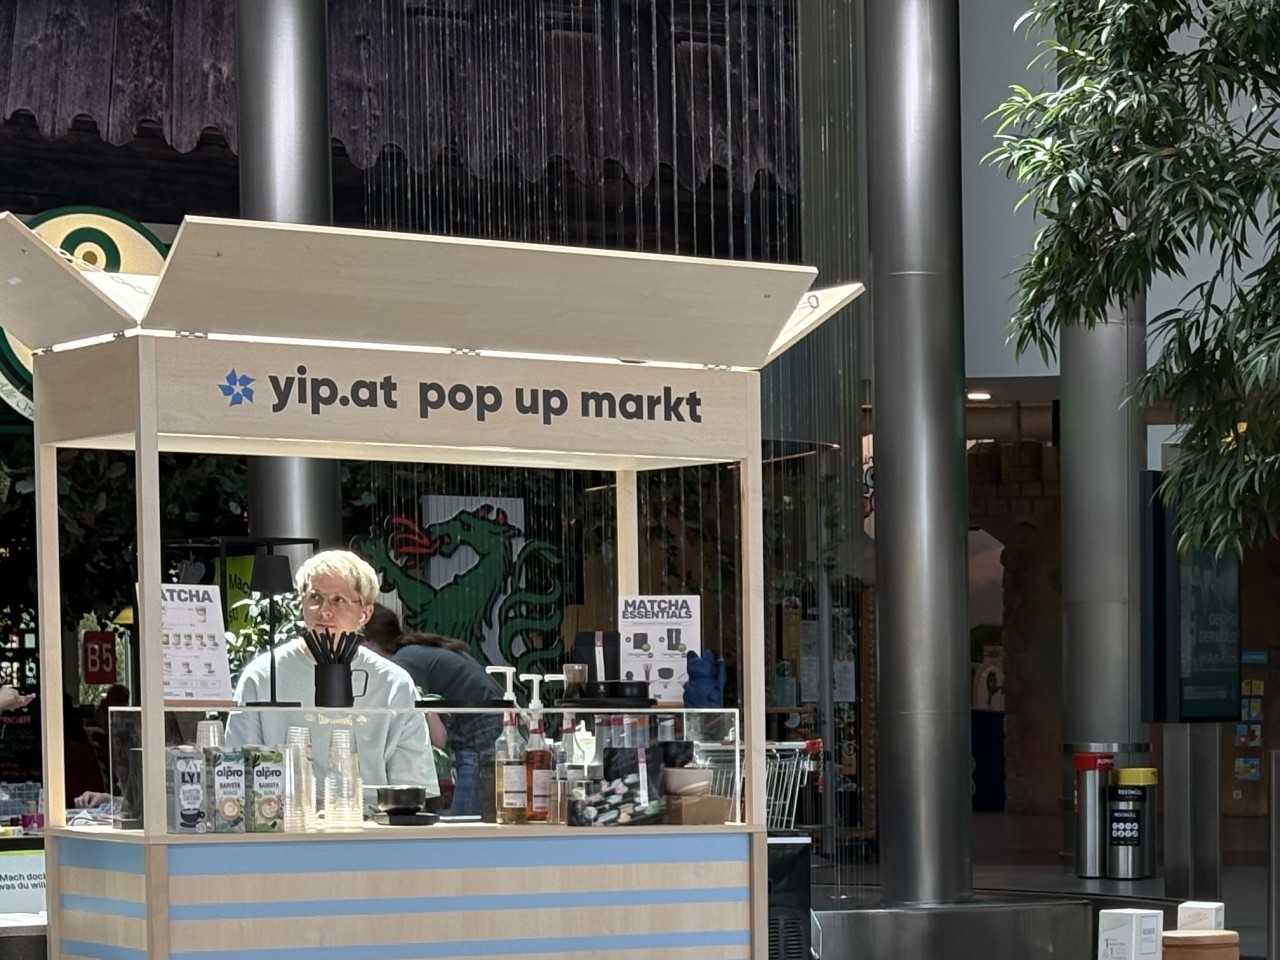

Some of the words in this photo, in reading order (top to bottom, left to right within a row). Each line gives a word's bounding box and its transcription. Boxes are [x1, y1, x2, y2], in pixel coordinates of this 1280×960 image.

[268, 365, 398, 415] yip.at
[419, 382, 503, 422] pop
[515, 387, 568, 425] up
[581, 386, 702, 423] markt
[161, 588, 213, 603] ATCHA
[624, 599, 691, 611] MATCHA
[622, 610, 693, 619] ESSENTIALS
[87, 643, 113, 673] B5
[216, 766, 243, 779] alpro
[255, 766, 282, 779] alpro
[0, 873, 26, 881] Mach
[17, 882, 29, 890] du
